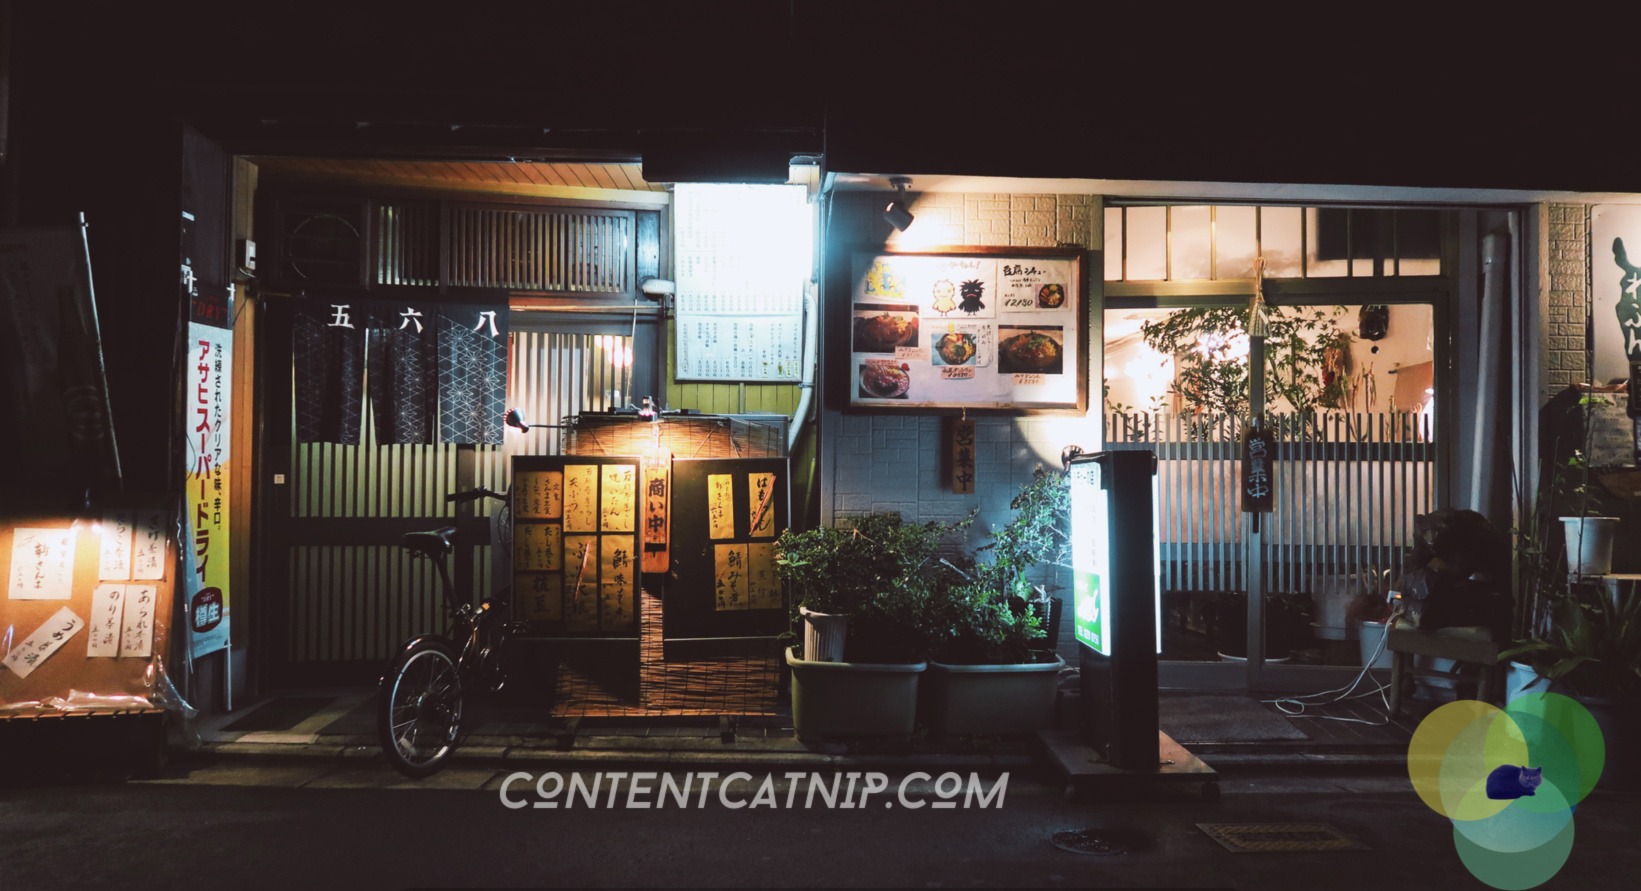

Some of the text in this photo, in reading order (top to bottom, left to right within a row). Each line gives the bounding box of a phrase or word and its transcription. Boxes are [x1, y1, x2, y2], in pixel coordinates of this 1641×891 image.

[195, 340, 212, 582] アサヒスーパードライ
[957, 425, 973, 491] 営業中
[1247, 437, 1269, 499] 営業中
[649, 478, 665, 533] 商い中
